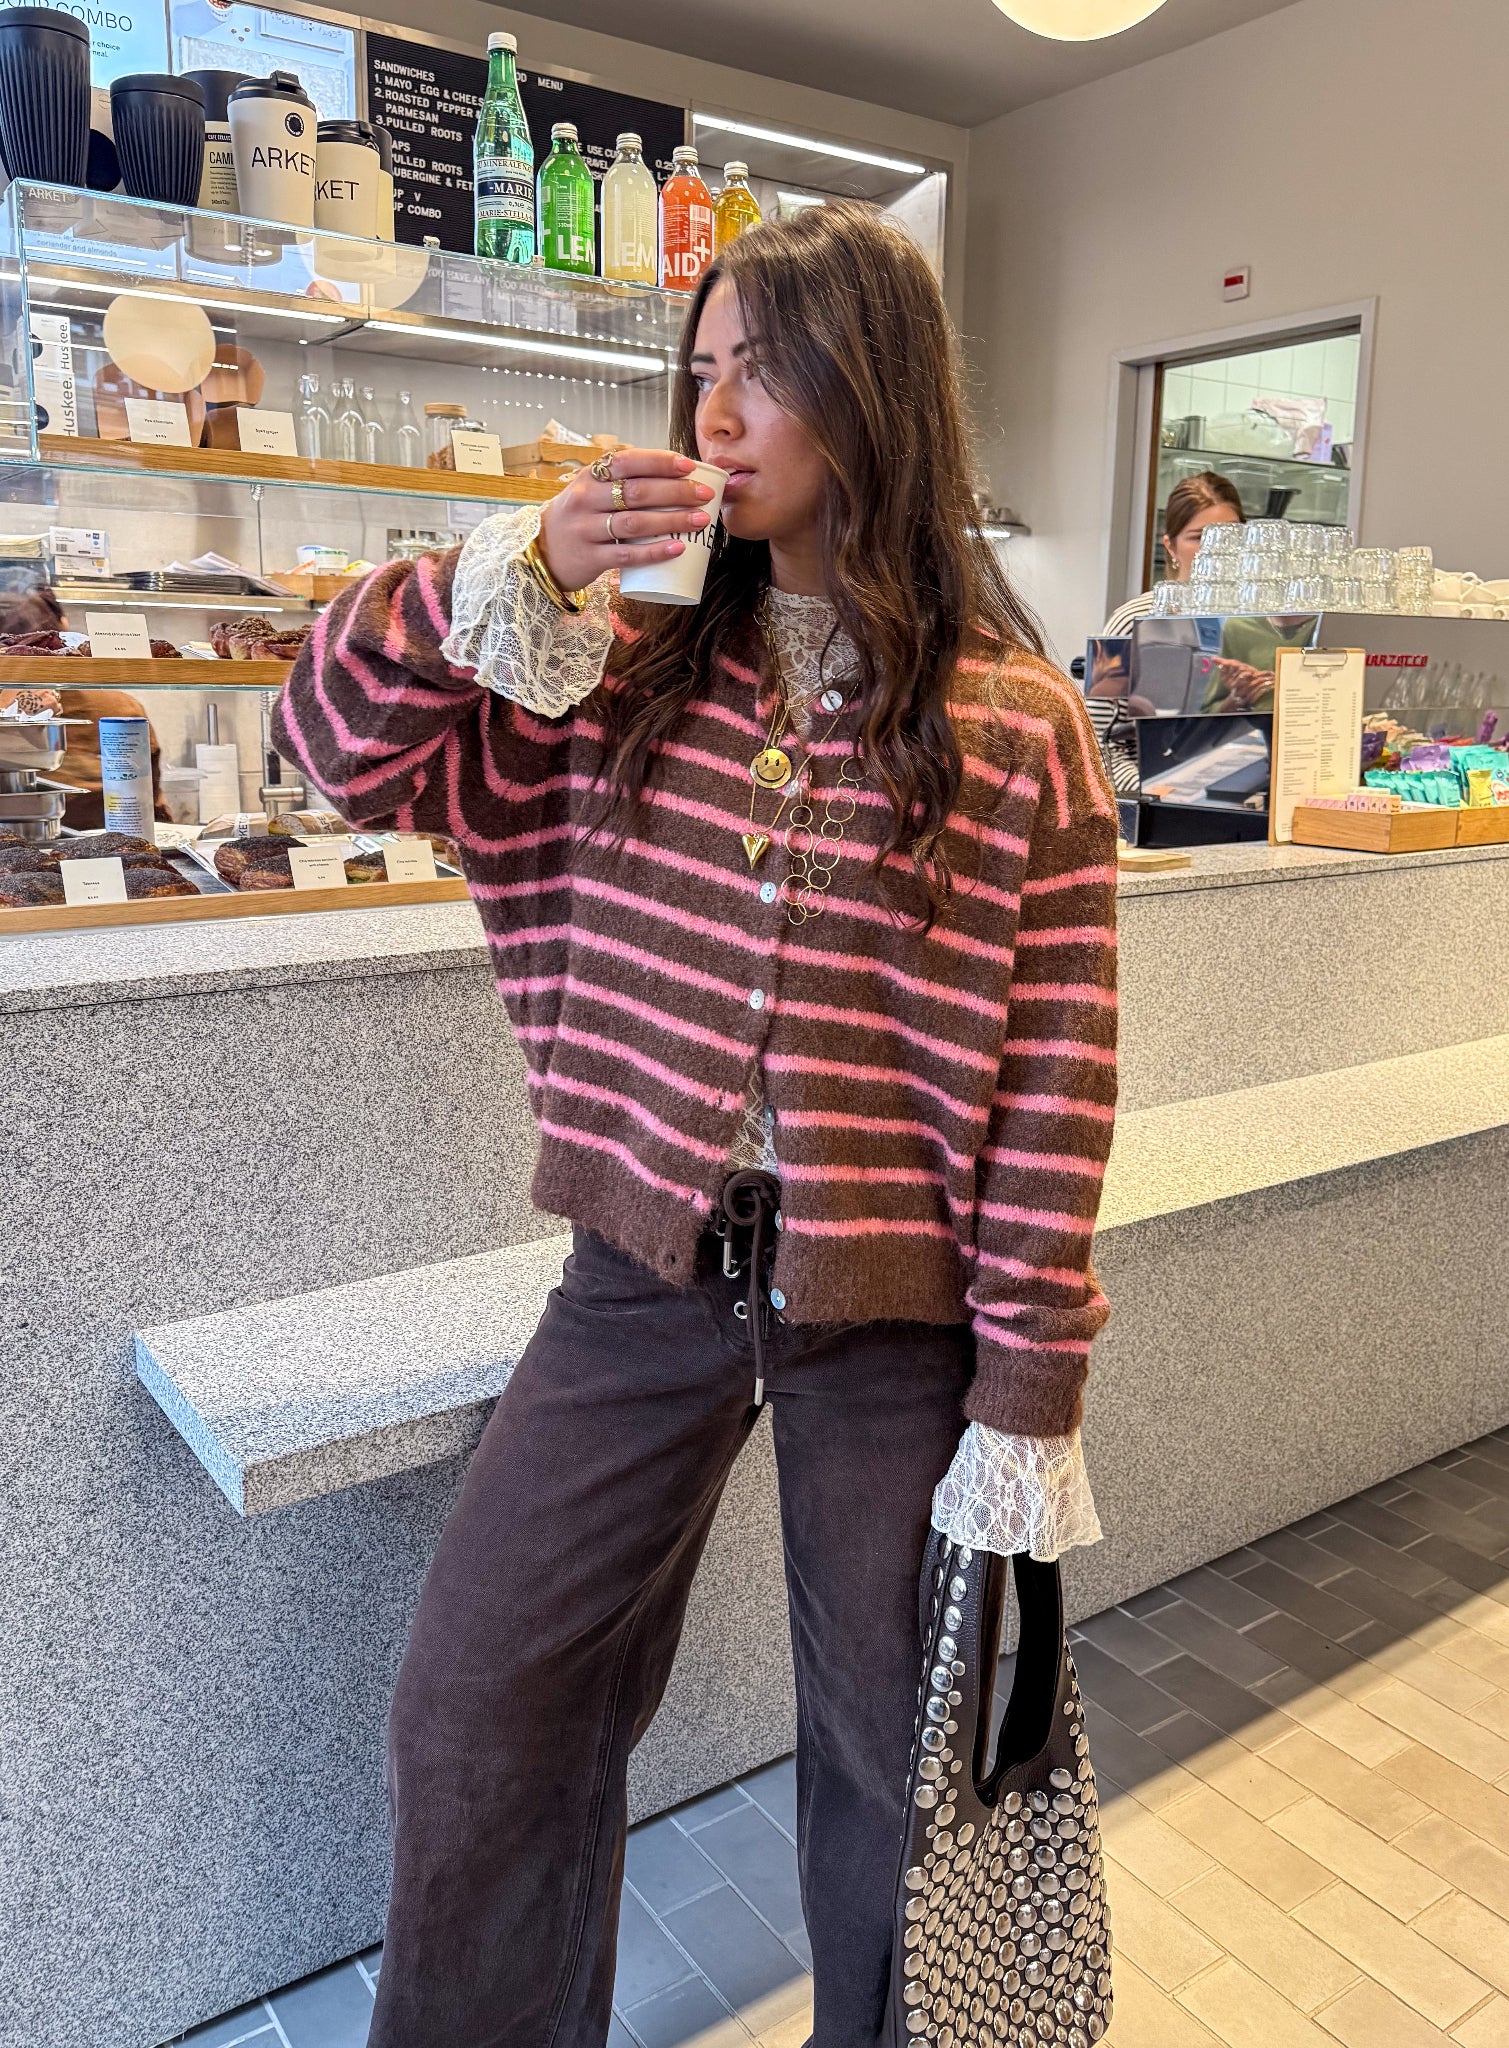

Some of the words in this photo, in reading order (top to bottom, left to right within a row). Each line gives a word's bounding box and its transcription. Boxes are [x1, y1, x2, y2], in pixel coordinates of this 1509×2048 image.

[374, 60, 435, 82] SANDWICHES
[384, 76, 412, 90] MAYO
[420, 84, 440, 97] EGG
[443, 89, 450, 100] &
[538, 77, 563, 91] MENU
[385, 103, 439, 124] PARMESAN
[436, 101, 473, 118] PEPPER
[430, 127, 463, 142] ROOTS
[587, 145, 603, 156] USE
[252, 147, 316, 178] ARKET
[432, 161, 463, 176] ROOTS
[315, 180, 359, 201] KET
[445, 177, 452, 188] &
[456, 180, 475, 192] FET
[28, 187, 67, 202] ARKET
[413, 192, 421, 201] V
[407, 204, 442, 219] COMBO
